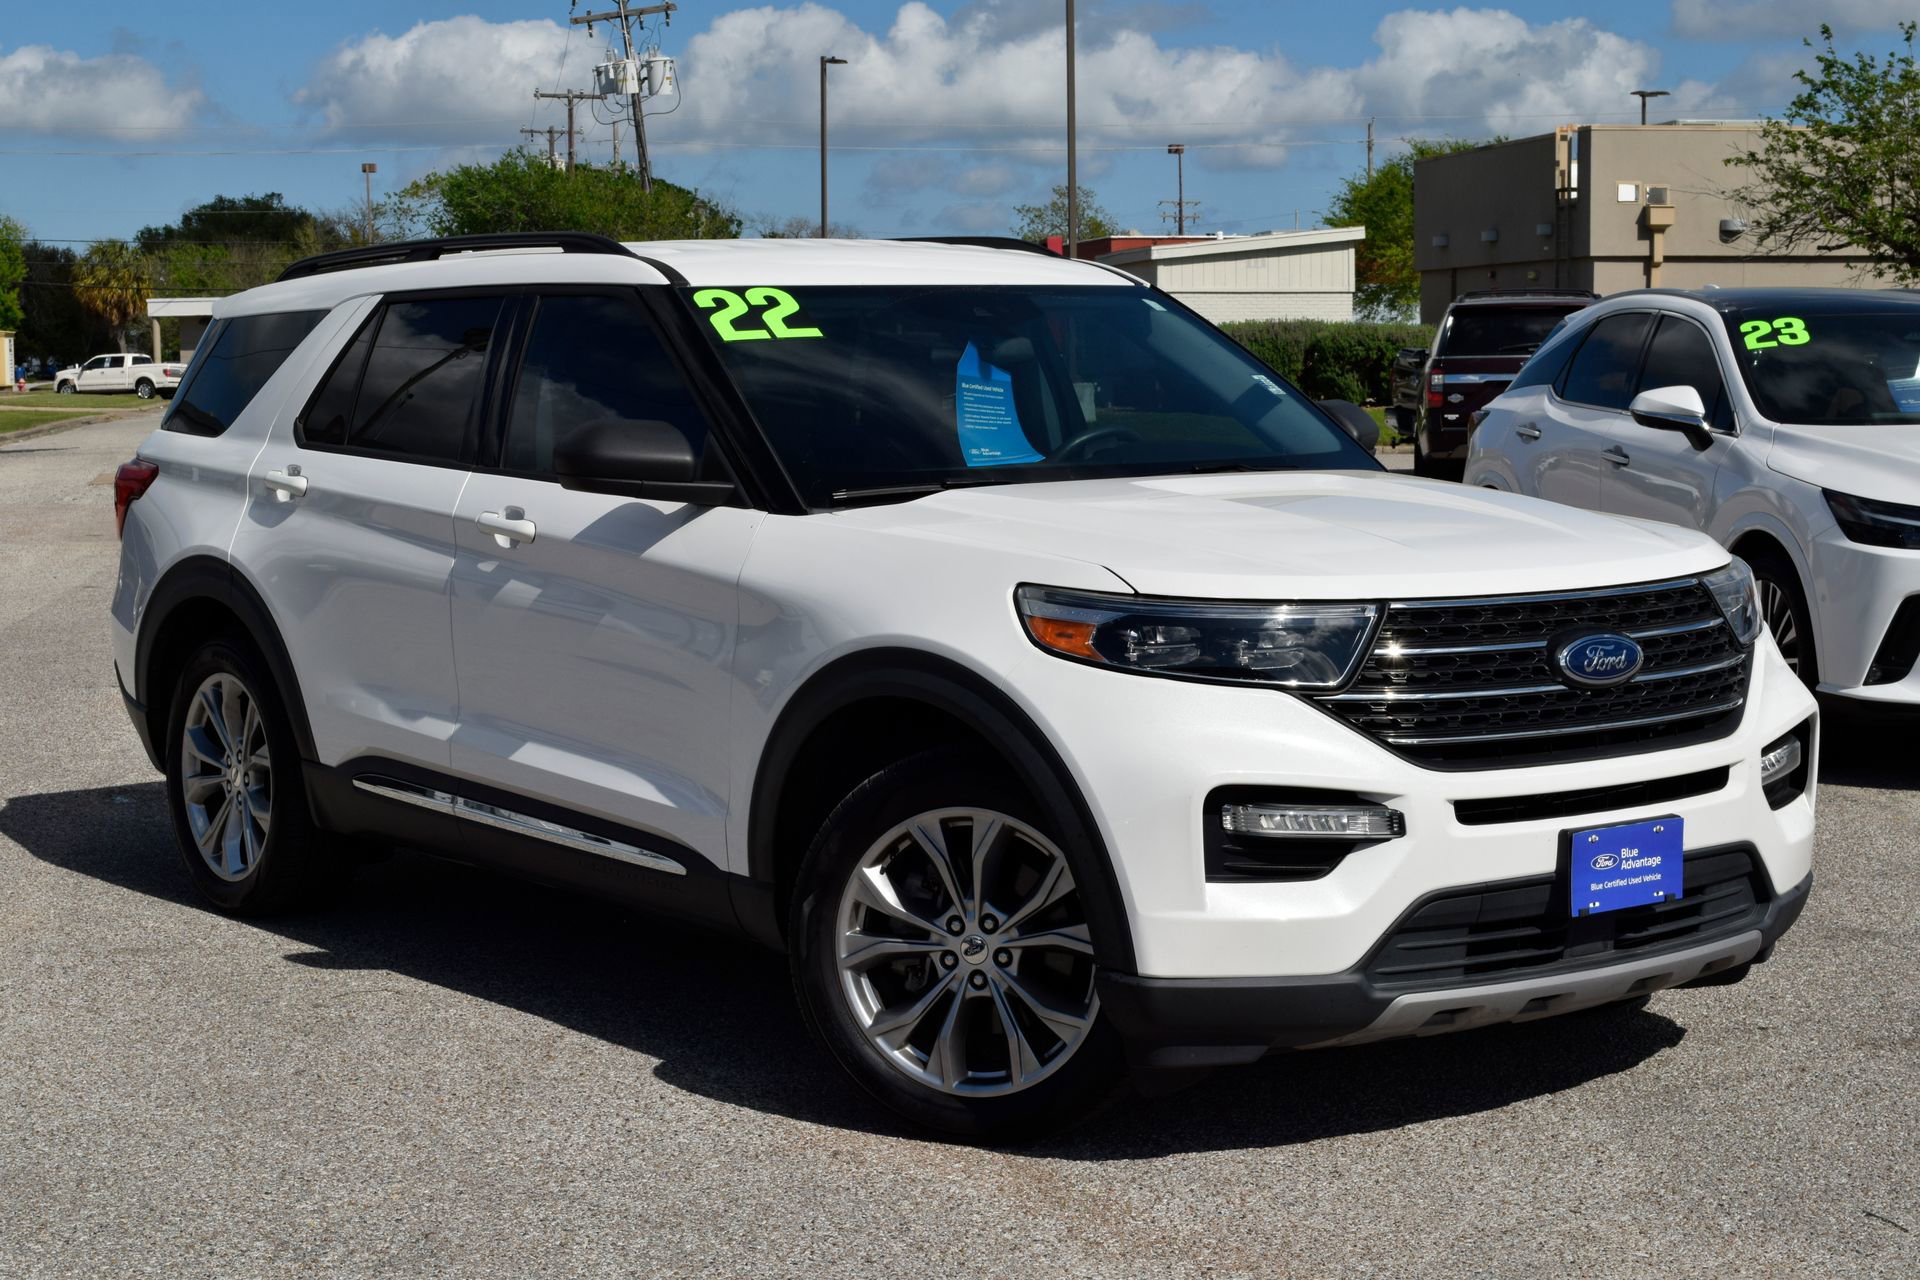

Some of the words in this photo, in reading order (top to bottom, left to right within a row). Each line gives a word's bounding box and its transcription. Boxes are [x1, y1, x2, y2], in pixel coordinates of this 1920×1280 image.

[693, 287, 823, 341] 22
[1740, 317, 1810, 350] 23
[1584, 644, 1628, 673] Ford
[1596, 856, 1614, 868] Ford
[1621, 848, 1639, 858] Blue
[1621, 856, 1661, 870] Advantage
[1590, 883, 1603, 891] Blue
[1604, 879, 1627, 889] Certified
[1628, 877, 1642, 885] Used
[1642, 873, 1662, 882] Vehicle
